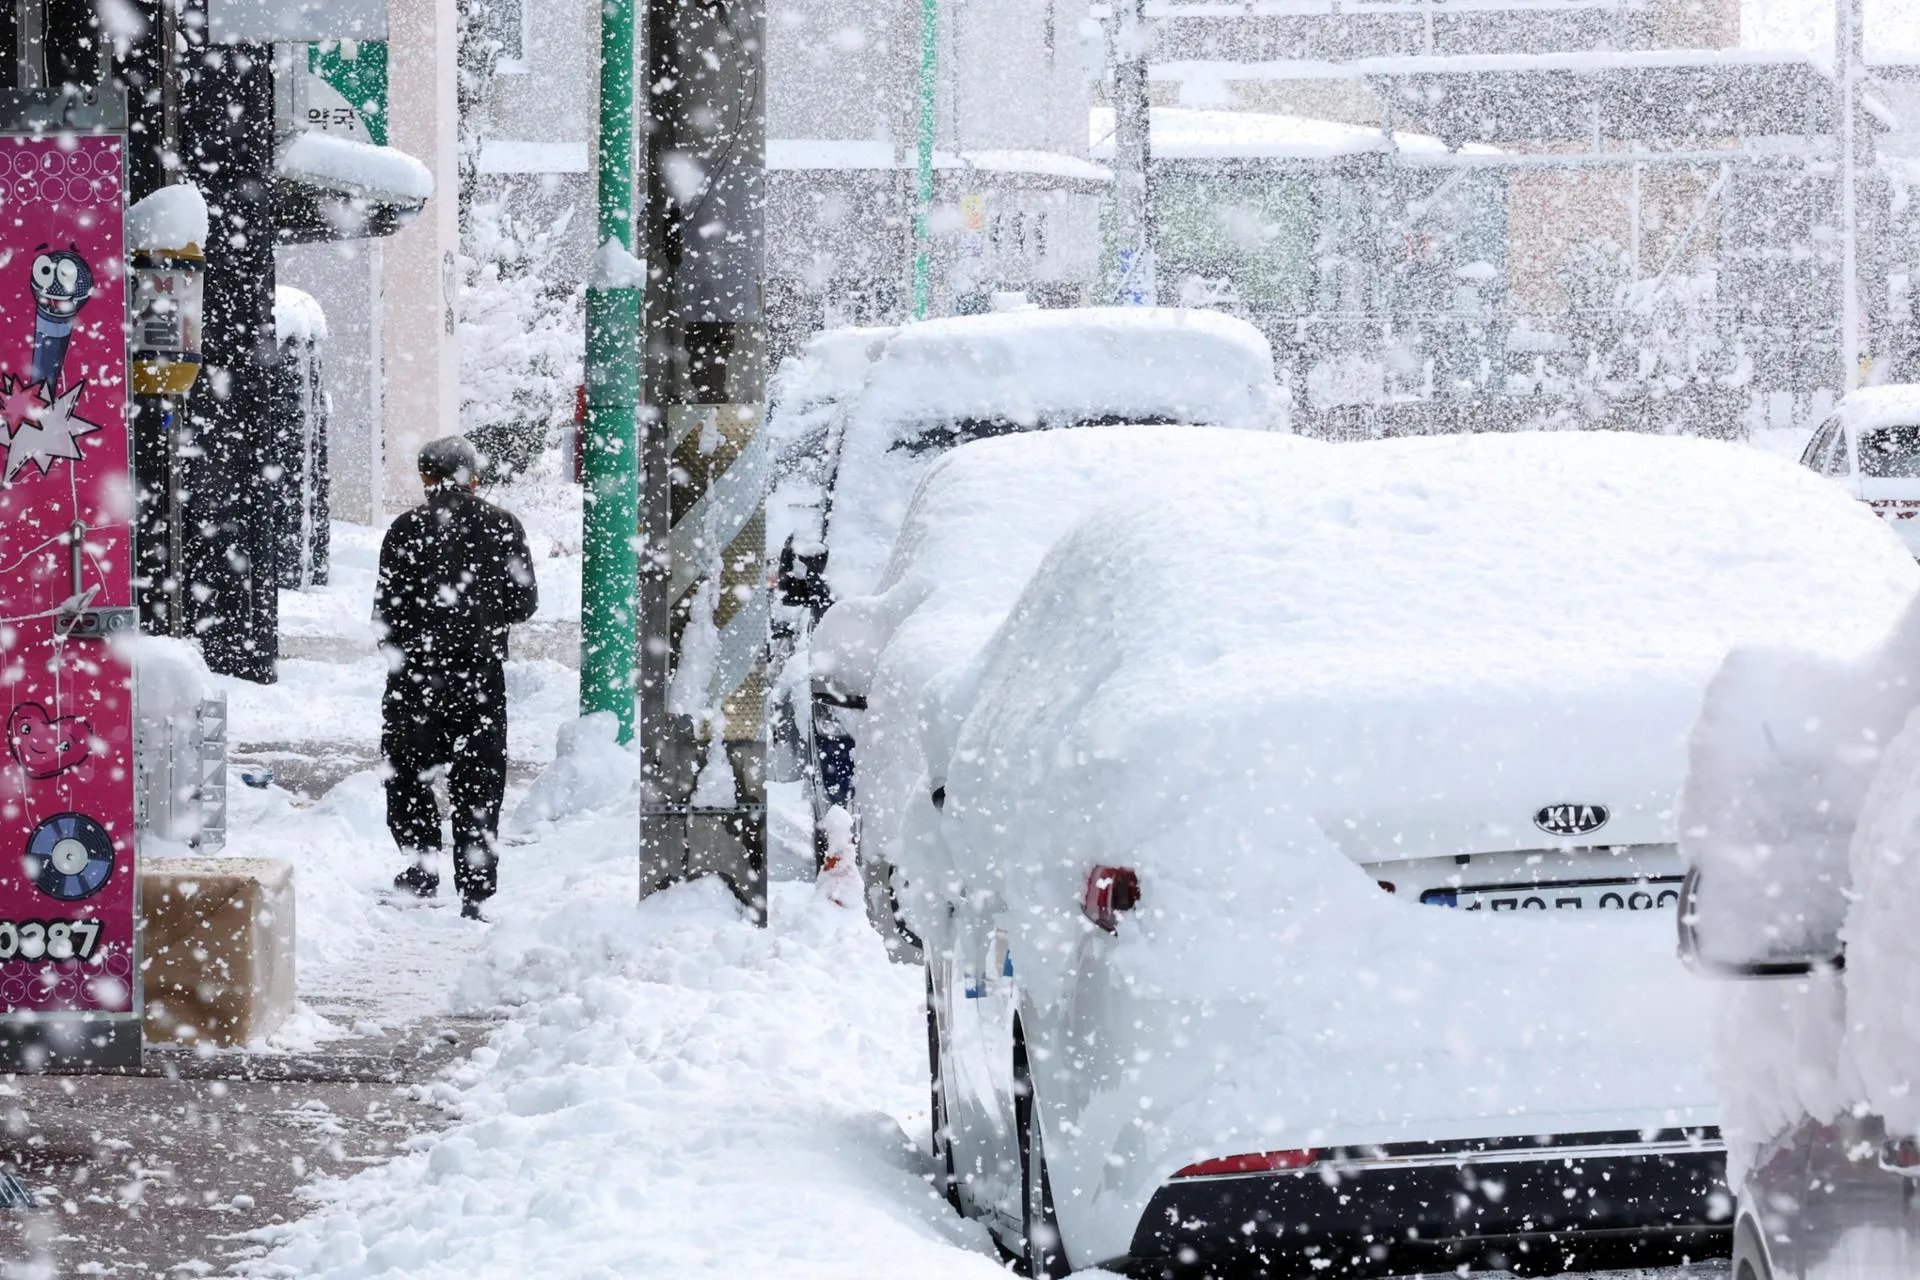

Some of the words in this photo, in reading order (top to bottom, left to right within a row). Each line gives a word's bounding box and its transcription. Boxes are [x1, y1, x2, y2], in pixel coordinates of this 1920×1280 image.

[307, 107, 355, 131] 약국
[1546, 805, 1599, 828] KIA
[0, 921, 101, 960] 0387
